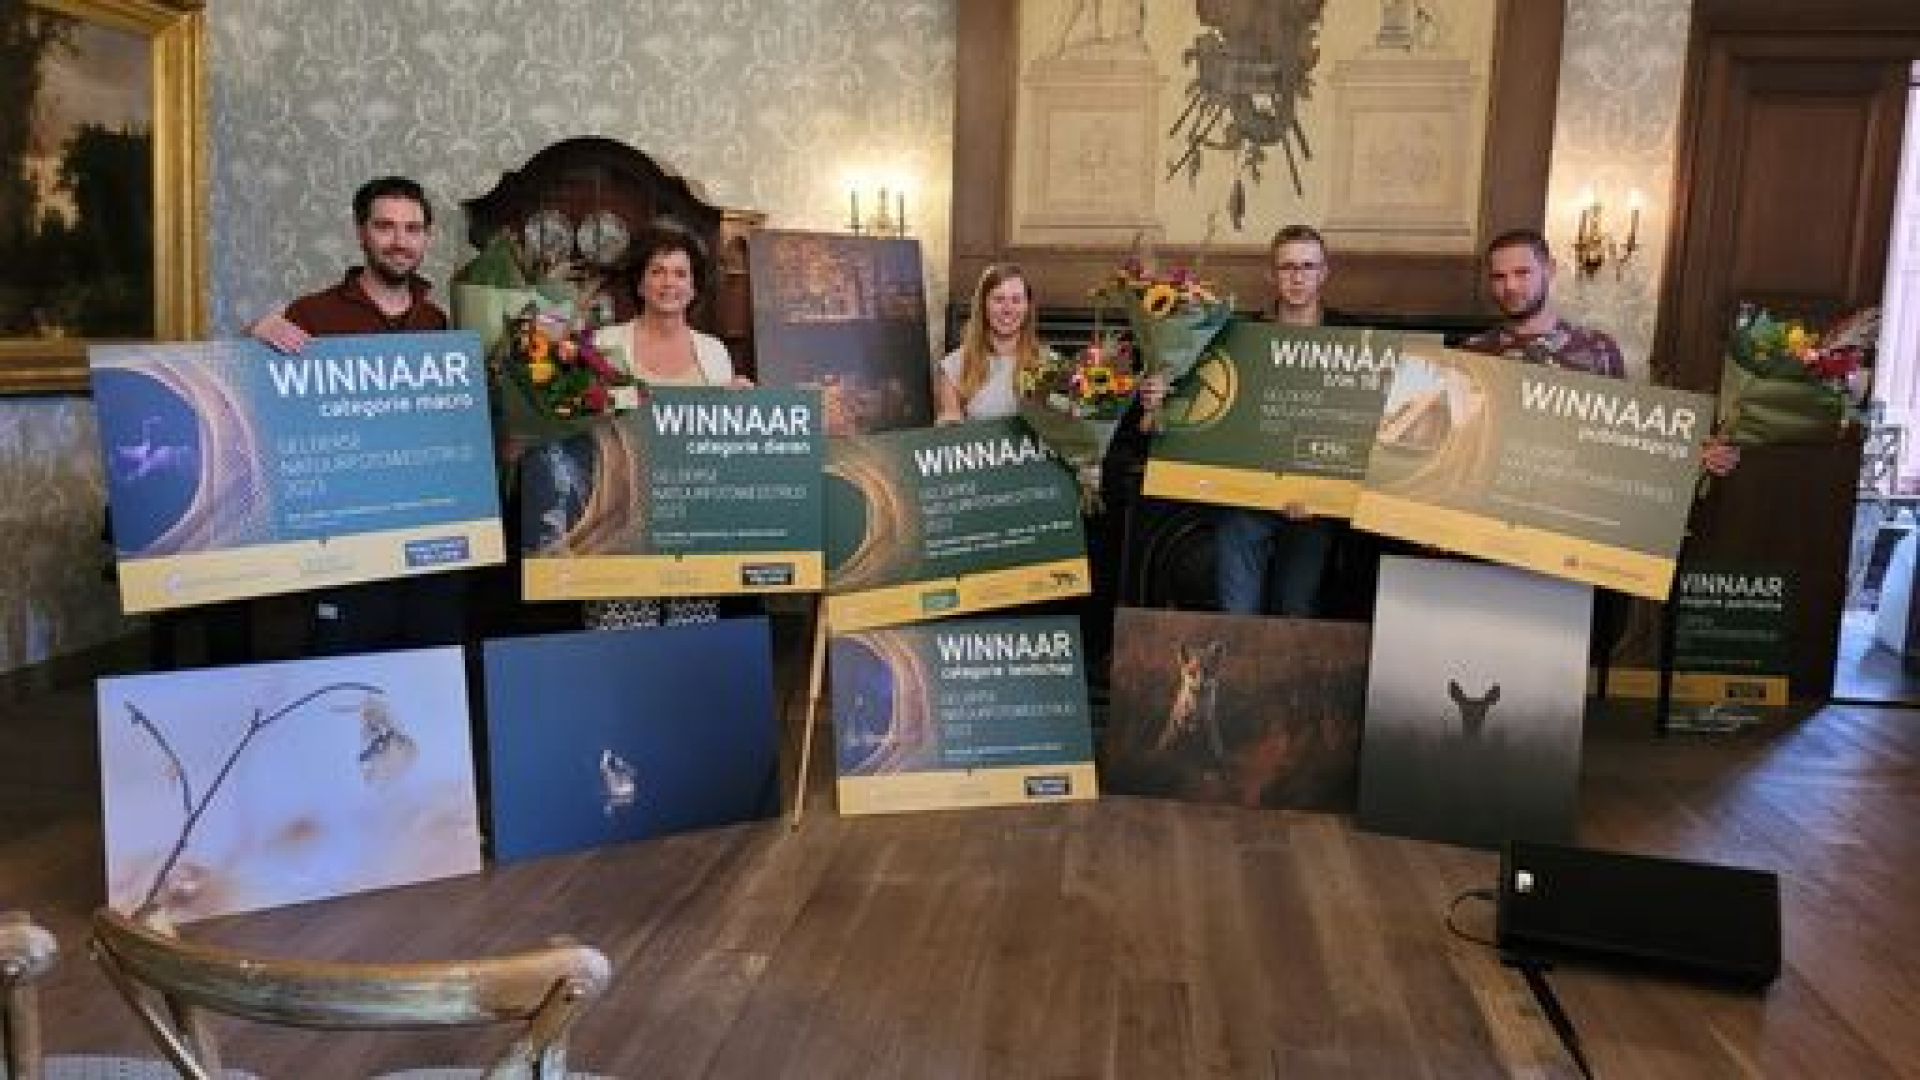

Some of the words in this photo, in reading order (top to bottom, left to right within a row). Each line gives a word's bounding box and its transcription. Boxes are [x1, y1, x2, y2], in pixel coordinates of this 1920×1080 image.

[1270, 341, 1396, 371] WINNAA
[268, 351, 470, 395] WINNAAR
[318, 397, 411, 418] categorie
[416, 393, 474, 411] macro
[652, 405, 810, 435] WINNAAR
[1522, 382, 1696, 439] WINNAAR
[686, 440, 758, 458] categorie
[764, 440, 811, 455] dieren
[937, 630, 1073, 660] WINNAAR
